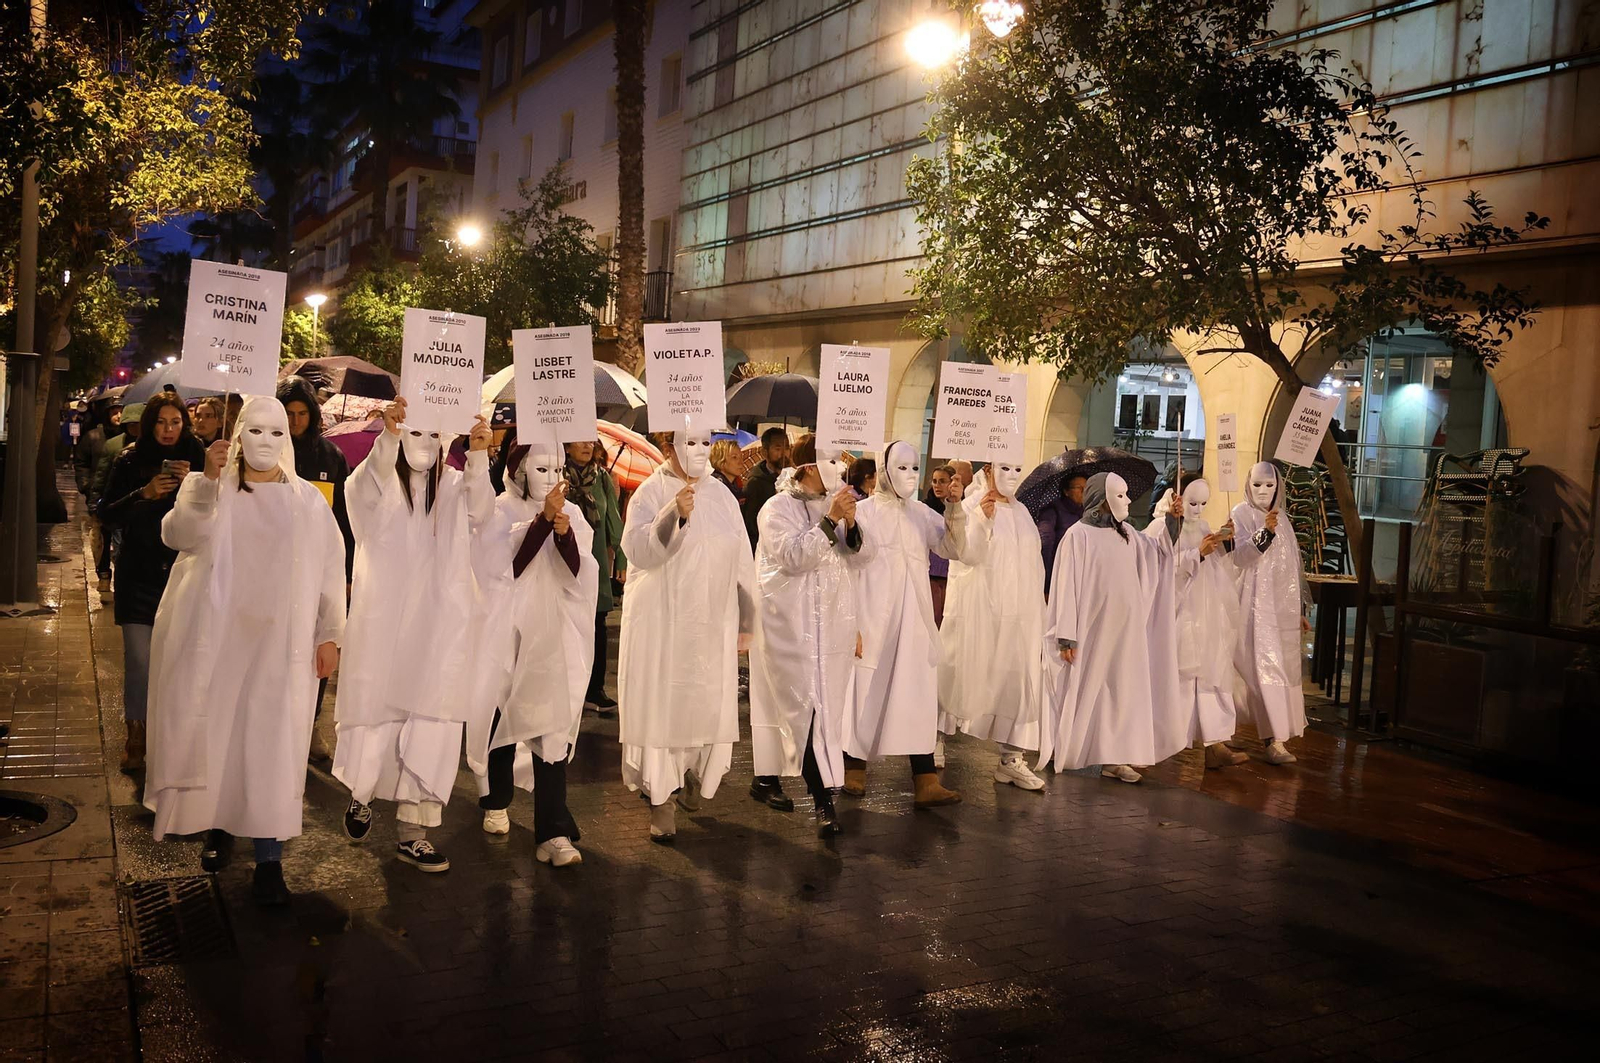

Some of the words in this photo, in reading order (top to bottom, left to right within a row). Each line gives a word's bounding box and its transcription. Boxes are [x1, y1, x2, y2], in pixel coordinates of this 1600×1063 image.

[218, 269, 247, 277] ASESINADA
[205, 294, 267, 312] CRISTINA
[213, 309, 257, 324] MARÍN
[210, 336, 226, 348] 24
[227, 341, 254, 352] años
[428, 341, 462, 354] JULIA
[219, 354, 243, 364] LEPE
[413, 352, 475, 368] MADRUGA
[534, 356, 572, 368] LISBET
[207, 362, 252, 376] (HLVA)
[532, 369, 576, 380] LASTRE
[667, 374, 679, 383] 34
[680, 374, 704, 382] años
[837, 372, 870, 382] LAURA
[423, 381, 436, 392] 56
[438, 384, 463, 394] años
[833, 384, 873, 394] LUELMO
[944, 386, 992, 398] FRANCISCA
[424, 396, 460, 406] HUELVA
[537, 396, 550, 406] 28
[551, 396, 574, 405] años
[947, 398, 986, 408] PAREDES
[537, 408, 575, 416] AYAMONTE
[836, 406, 847, 416] 26
[848, 408, 868, 416] años
[1302, 407, 1322, 418] JUANA
[540, 416, 572, 424] (HUELVA)
[950, 418, 960, 427] 59
[960, 420, 978, 428] años
[1299, 415, 1318, 426] MARÍA
[954, 430, 970, 438] BEAS
[947, 438, 976, 446] (HUELVA)
